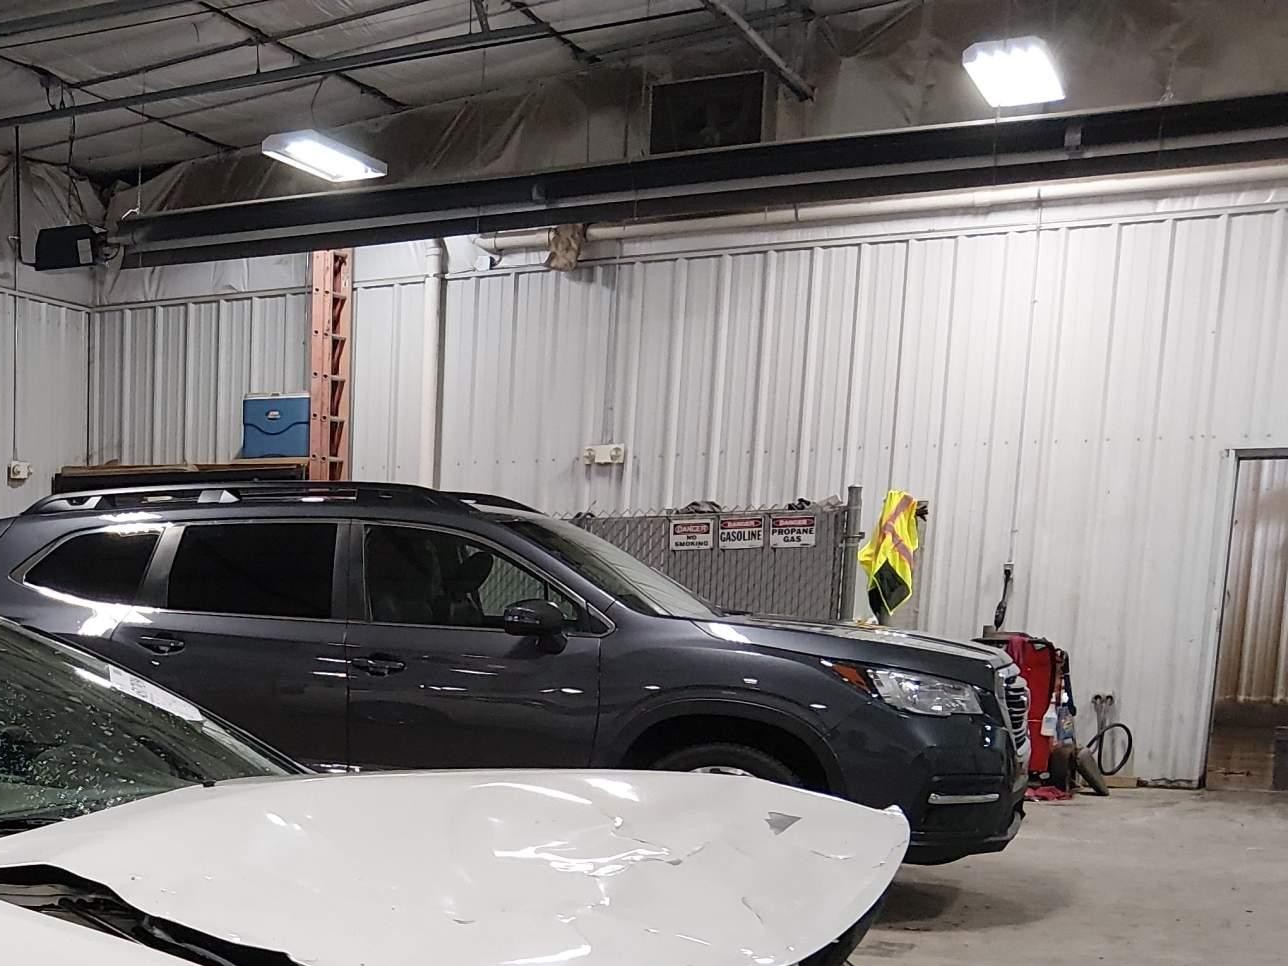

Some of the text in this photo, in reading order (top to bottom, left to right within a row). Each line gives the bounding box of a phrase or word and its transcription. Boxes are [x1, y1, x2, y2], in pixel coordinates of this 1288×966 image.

[675, 523, 709, 534] DANGER
[720, 529, 762, 542] GASOLINE
[782, 535, 802, 543] GAS
